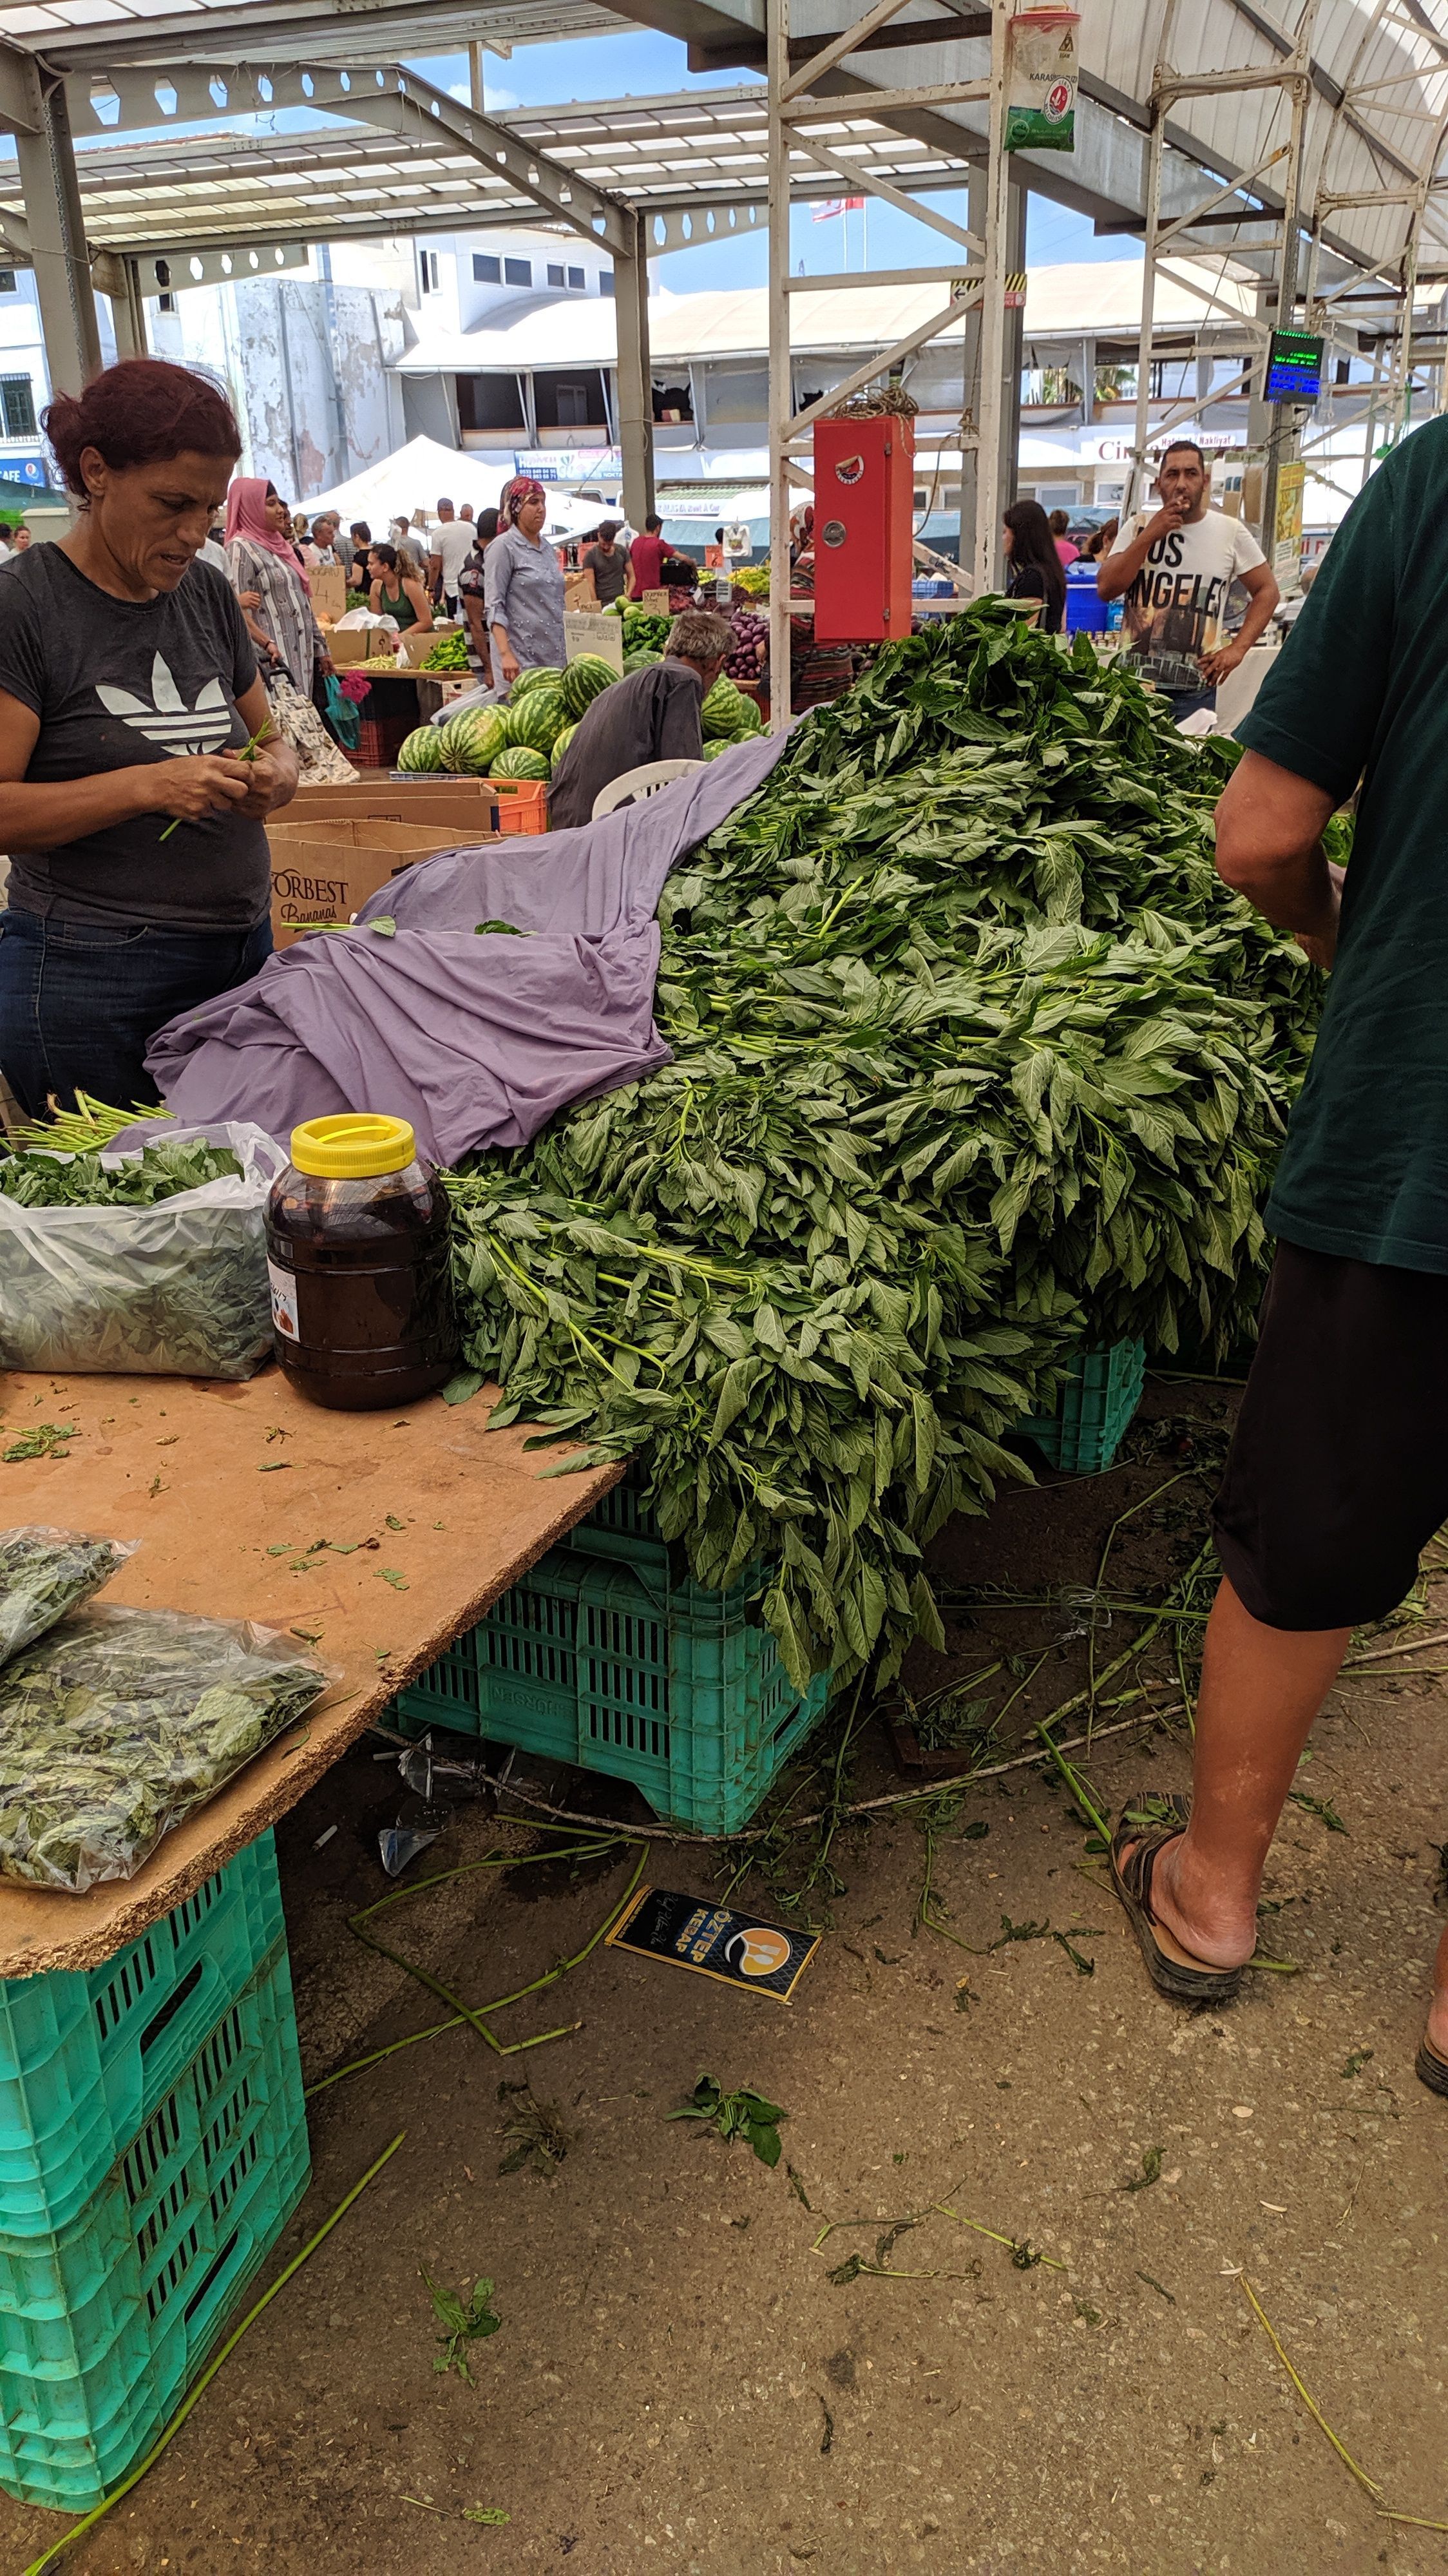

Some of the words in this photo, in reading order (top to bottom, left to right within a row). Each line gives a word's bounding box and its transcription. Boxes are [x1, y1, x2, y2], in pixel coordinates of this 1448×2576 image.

[1199, 435, 1232, 447] Nakliyat
[0, 470, 21, 483] AFE
[1138, 526, 1185, 568] OS
[1127, 569, 1227, 620] ANGELES
[271, 869, 348, 905] ORBEST
[281, 903, 337, 923] Bananas
[674, 1908, 709, 1953] KEBAP
[691, 1908, 733, 1963] ÖZTEP
